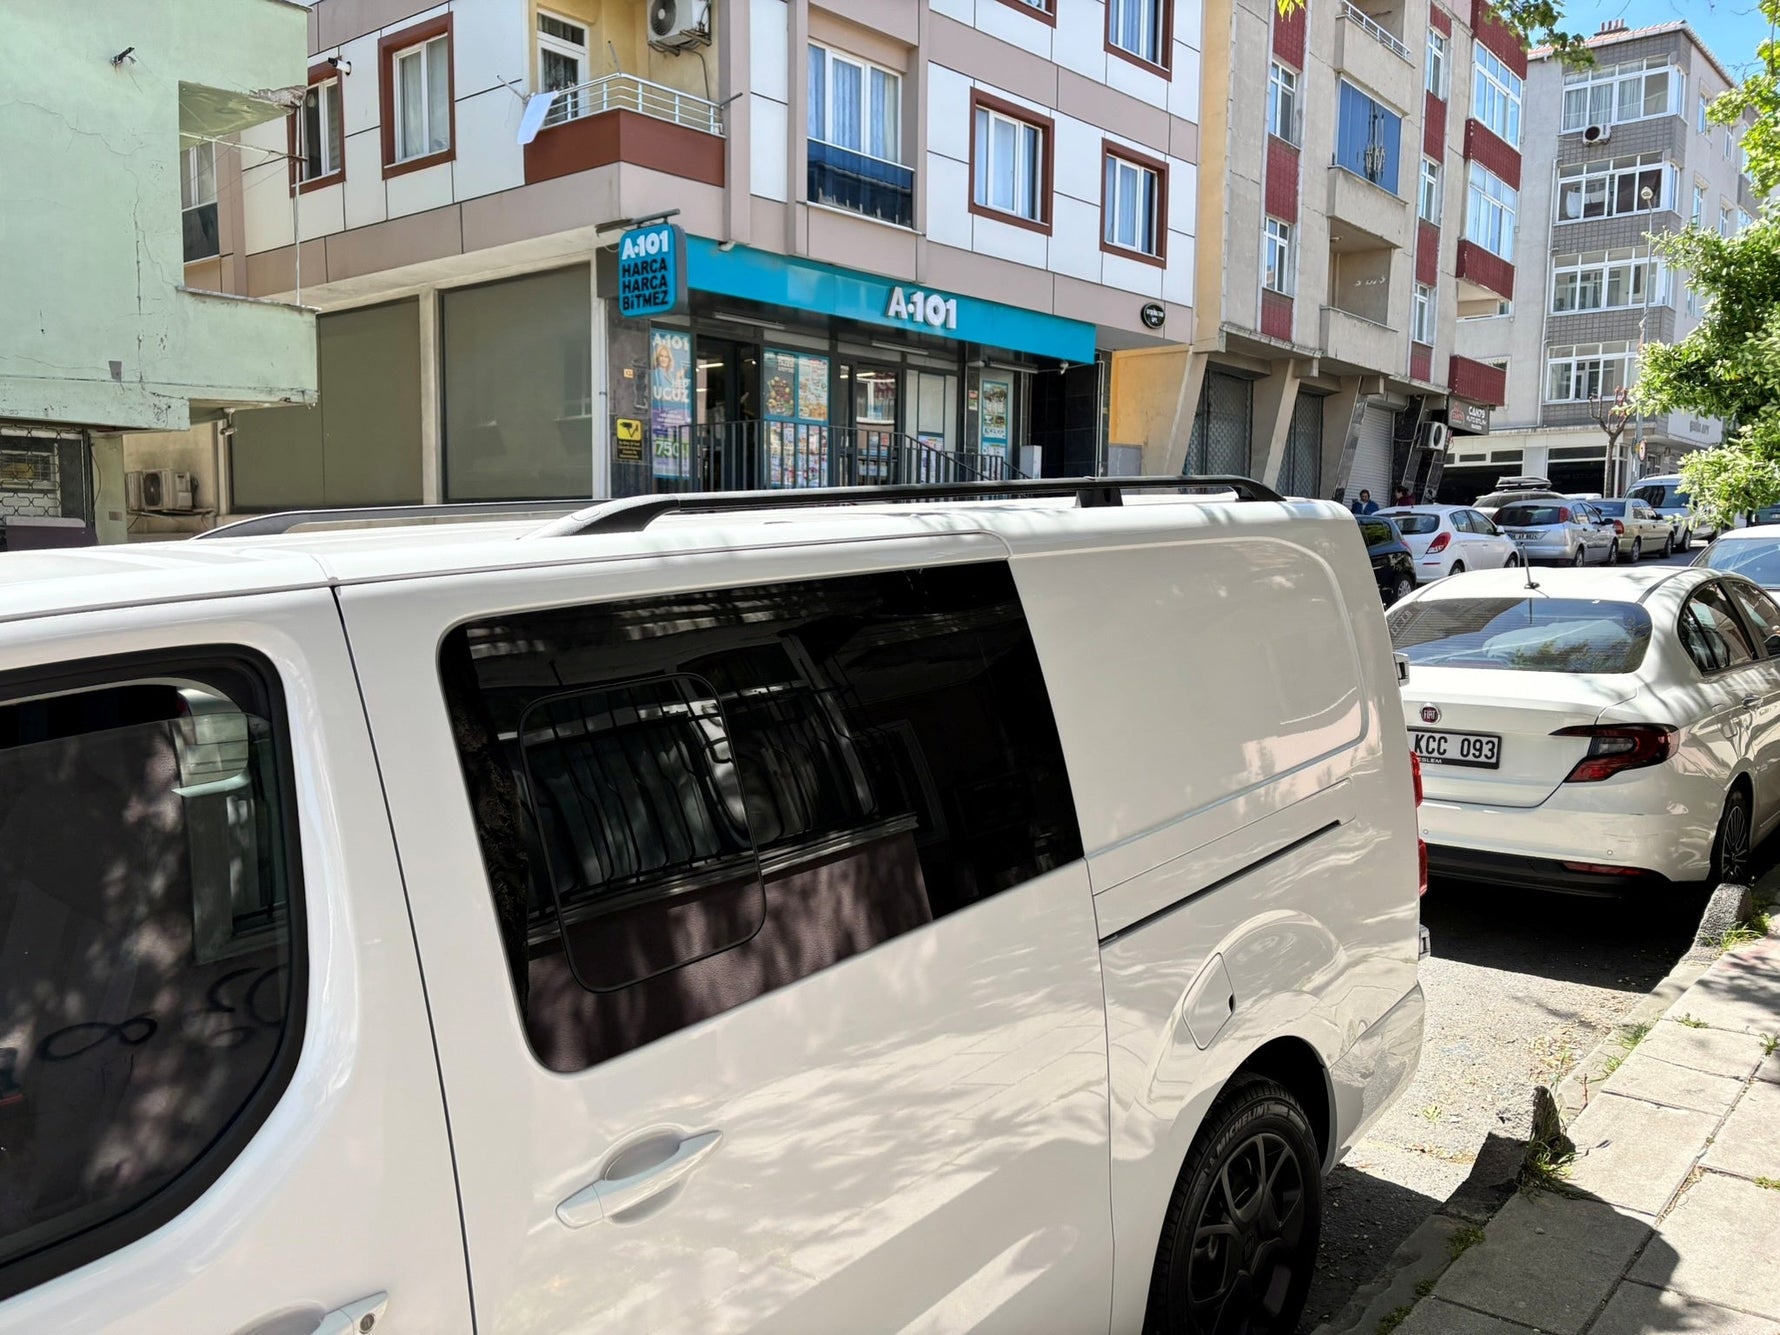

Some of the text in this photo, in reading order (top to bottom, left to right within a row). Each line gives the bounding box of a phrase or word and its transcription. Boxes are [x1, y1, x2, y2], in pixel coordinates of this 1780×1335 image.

[622, 257, 668, 278] HARCA
[622, 274, 668, 295] HARCA
[1423, 709, 1436, 720] FIAT
[1414, 734, 1496, 760] KCC 093
[1216, 1104, 1265, 1155] MICHELIN
